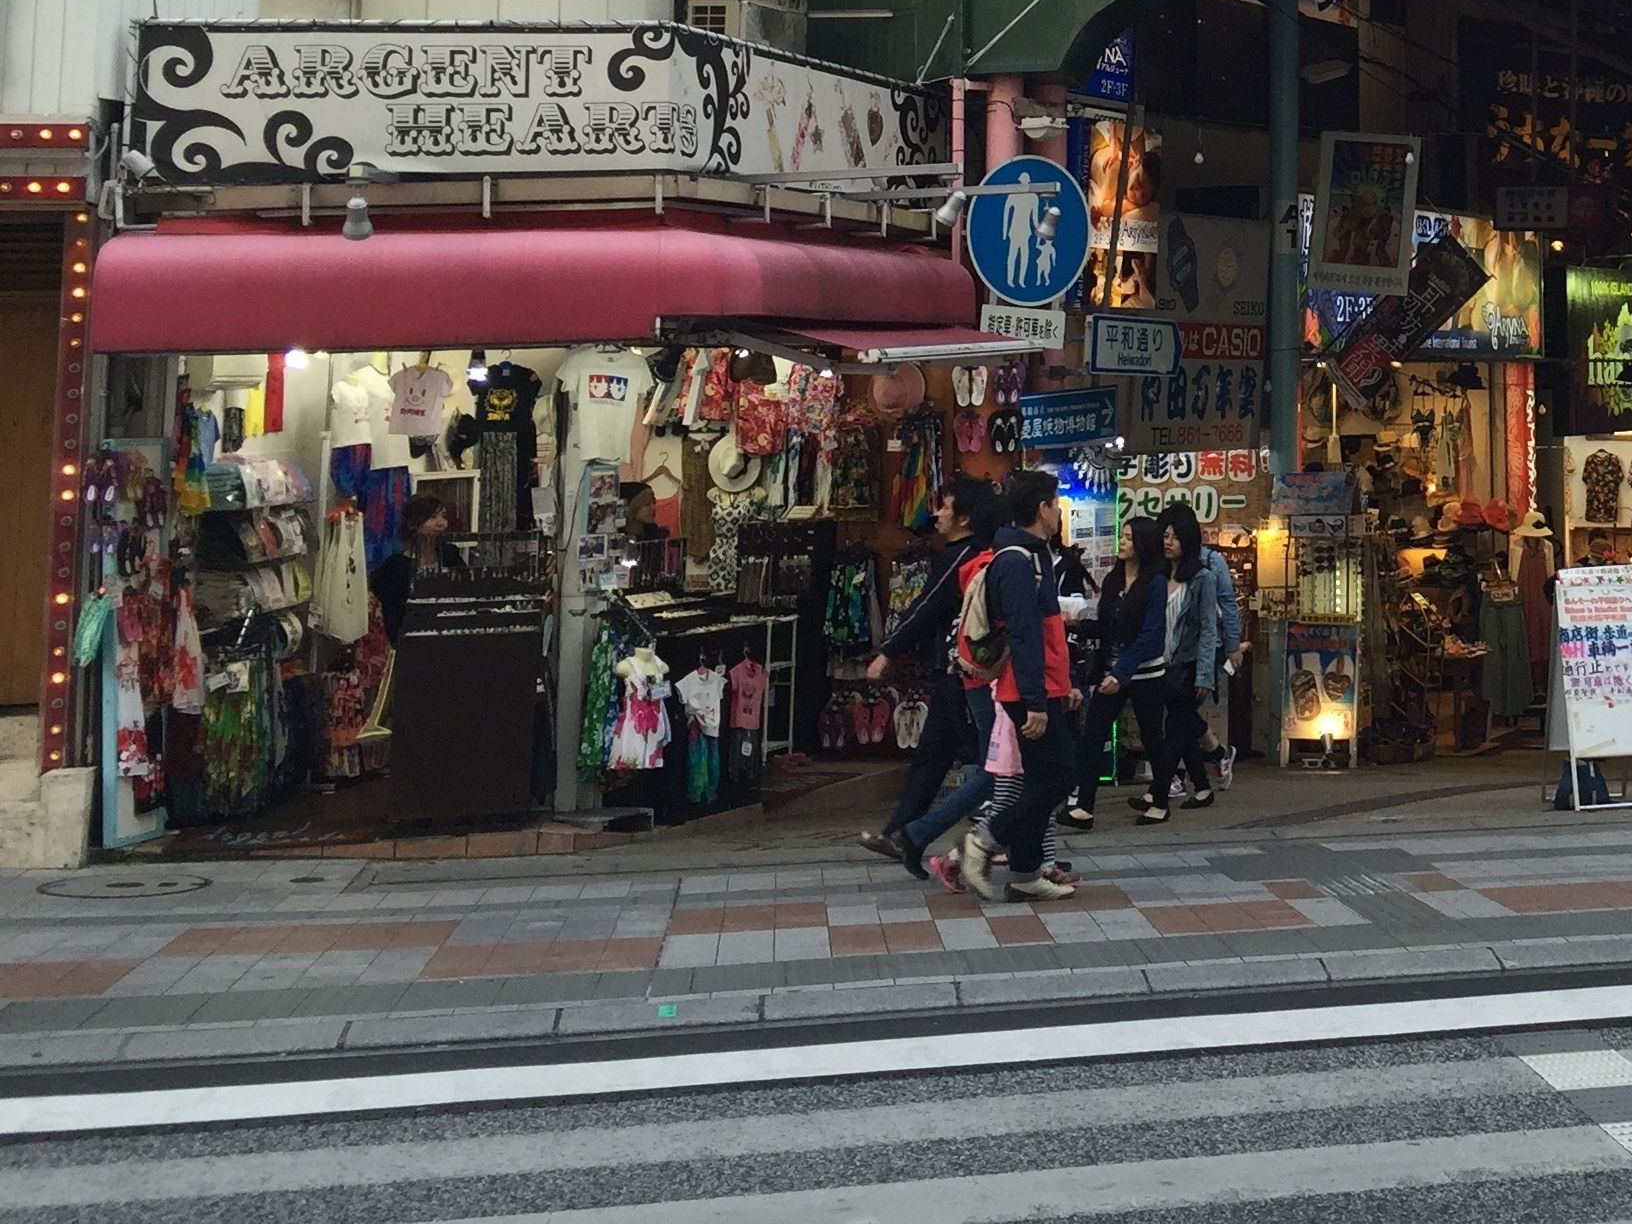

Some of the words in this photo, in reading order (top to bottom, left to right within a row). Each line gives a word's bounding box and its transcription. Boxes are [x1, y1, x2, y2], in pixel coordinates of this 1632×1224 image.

[220, 43, 594, 99] ARGENT
[385, 98, 698, 158] HEARTS
[1233, 300, 1265, 316] SEIKO
[1105, 324, 1164, 353] 平和通り
[1202, 327, 1261, 358] CASIO
[1117, 352, 1152, 367] Heiwadori
[1151, 426, 1176, 446] TEL
